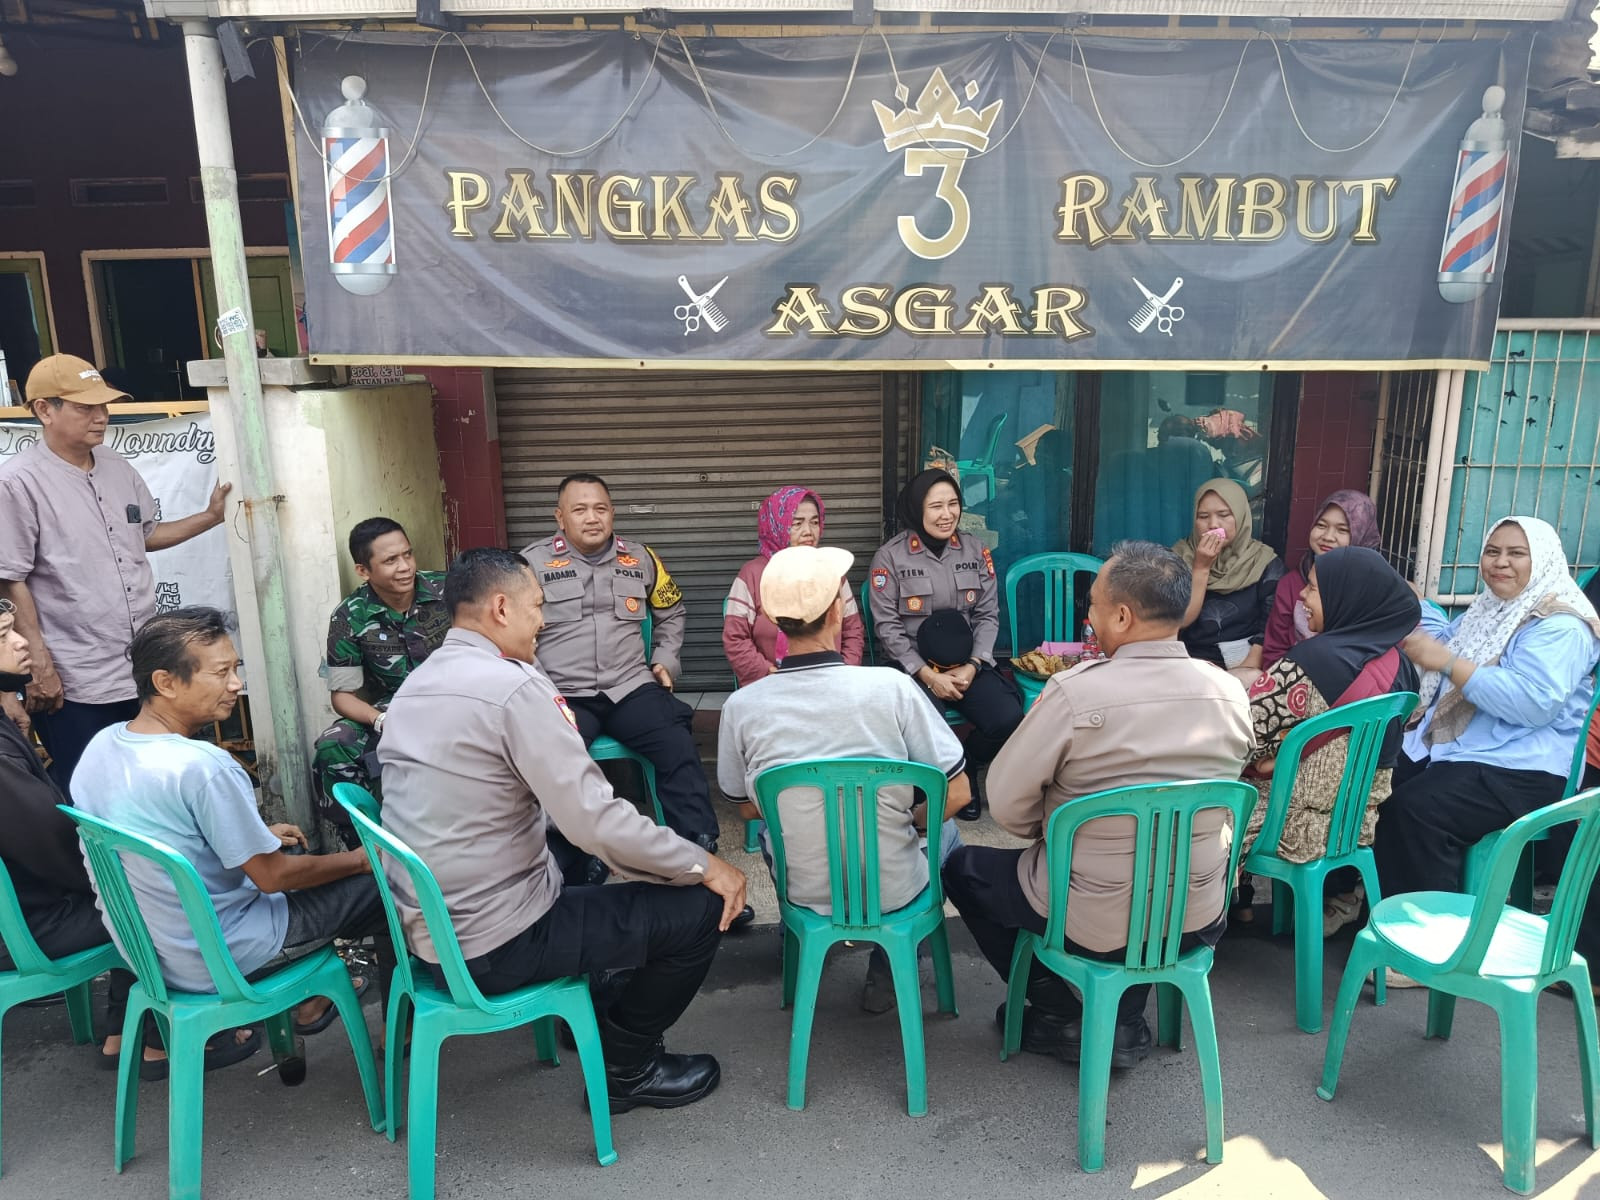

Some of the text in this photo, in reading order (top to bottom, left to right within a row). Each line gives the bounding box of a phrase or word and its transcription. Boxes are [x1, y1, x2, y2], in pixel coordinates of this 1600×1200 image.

[446, 148, 1397, 260] PANGKAS 3 RAMBUT
[765, 285, 1094, 341] ASGAR
[544, 569, 577, 583] MADARIS
[615, 568, 644, 579] POLRI
[900, 569, 924, 578] TIEN
